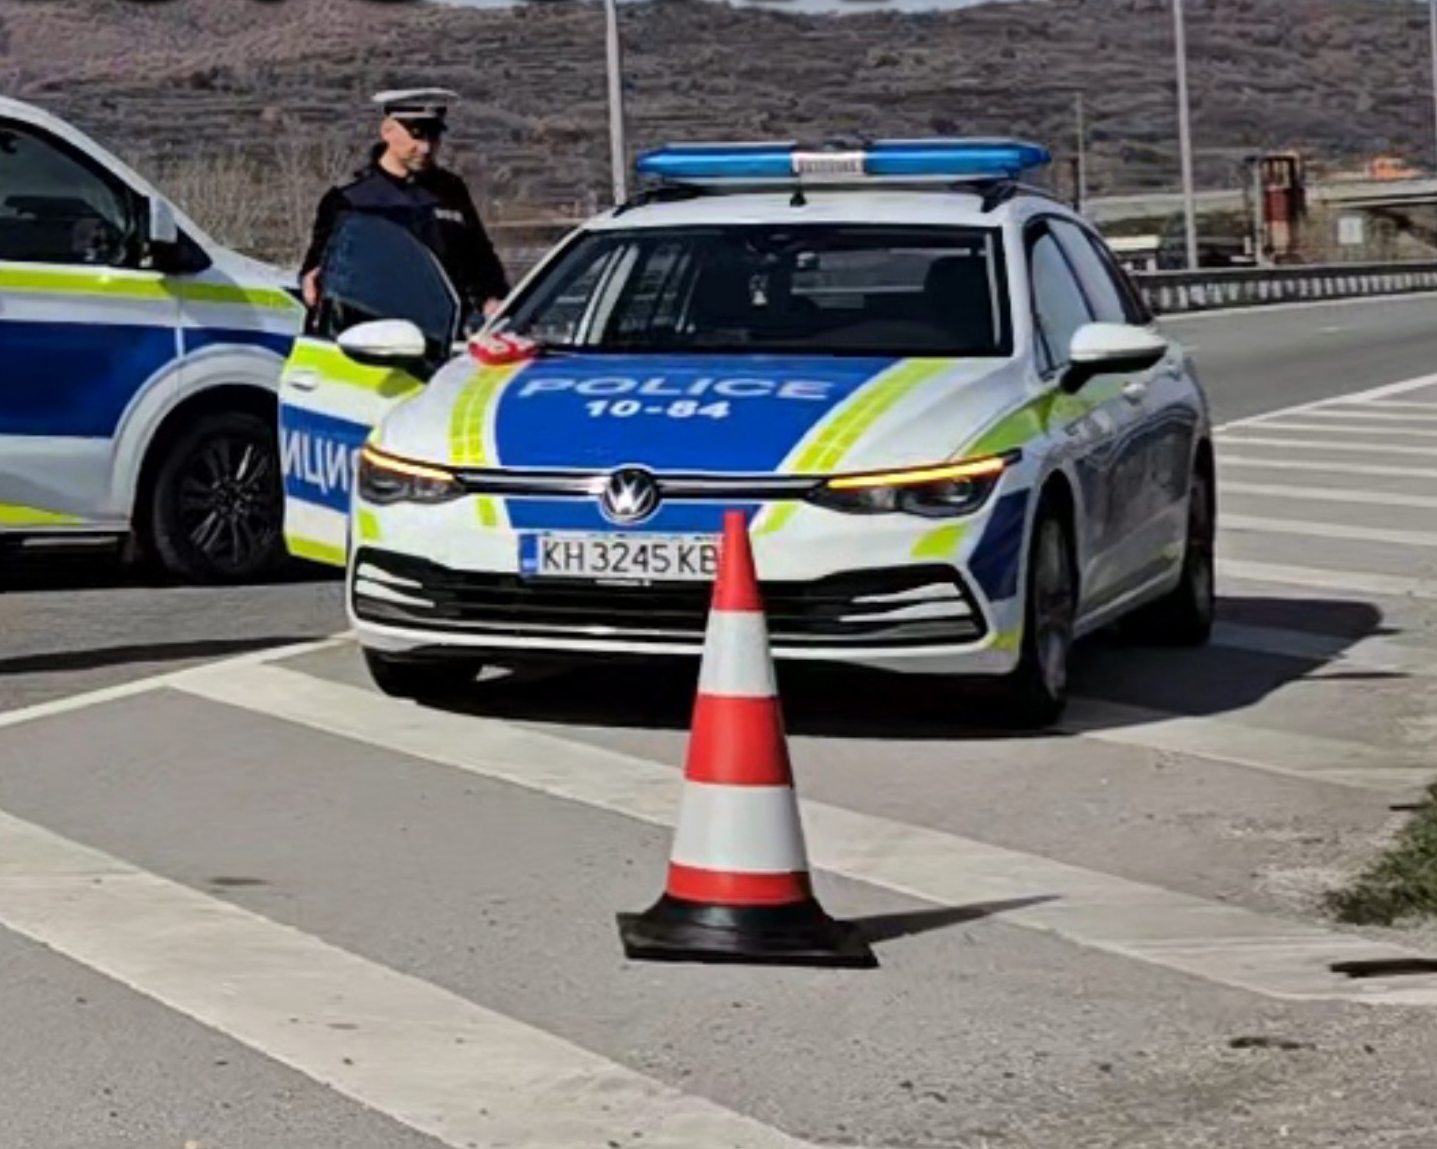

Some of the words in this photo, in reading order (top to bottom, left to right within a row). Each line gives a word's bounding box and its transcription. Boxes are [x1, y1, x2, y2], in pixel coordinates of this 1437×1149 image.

[518, 378, 833, 399] POLICE
[542, 540, 584, 572] KH
[590, 542, 671, 573] 3245
